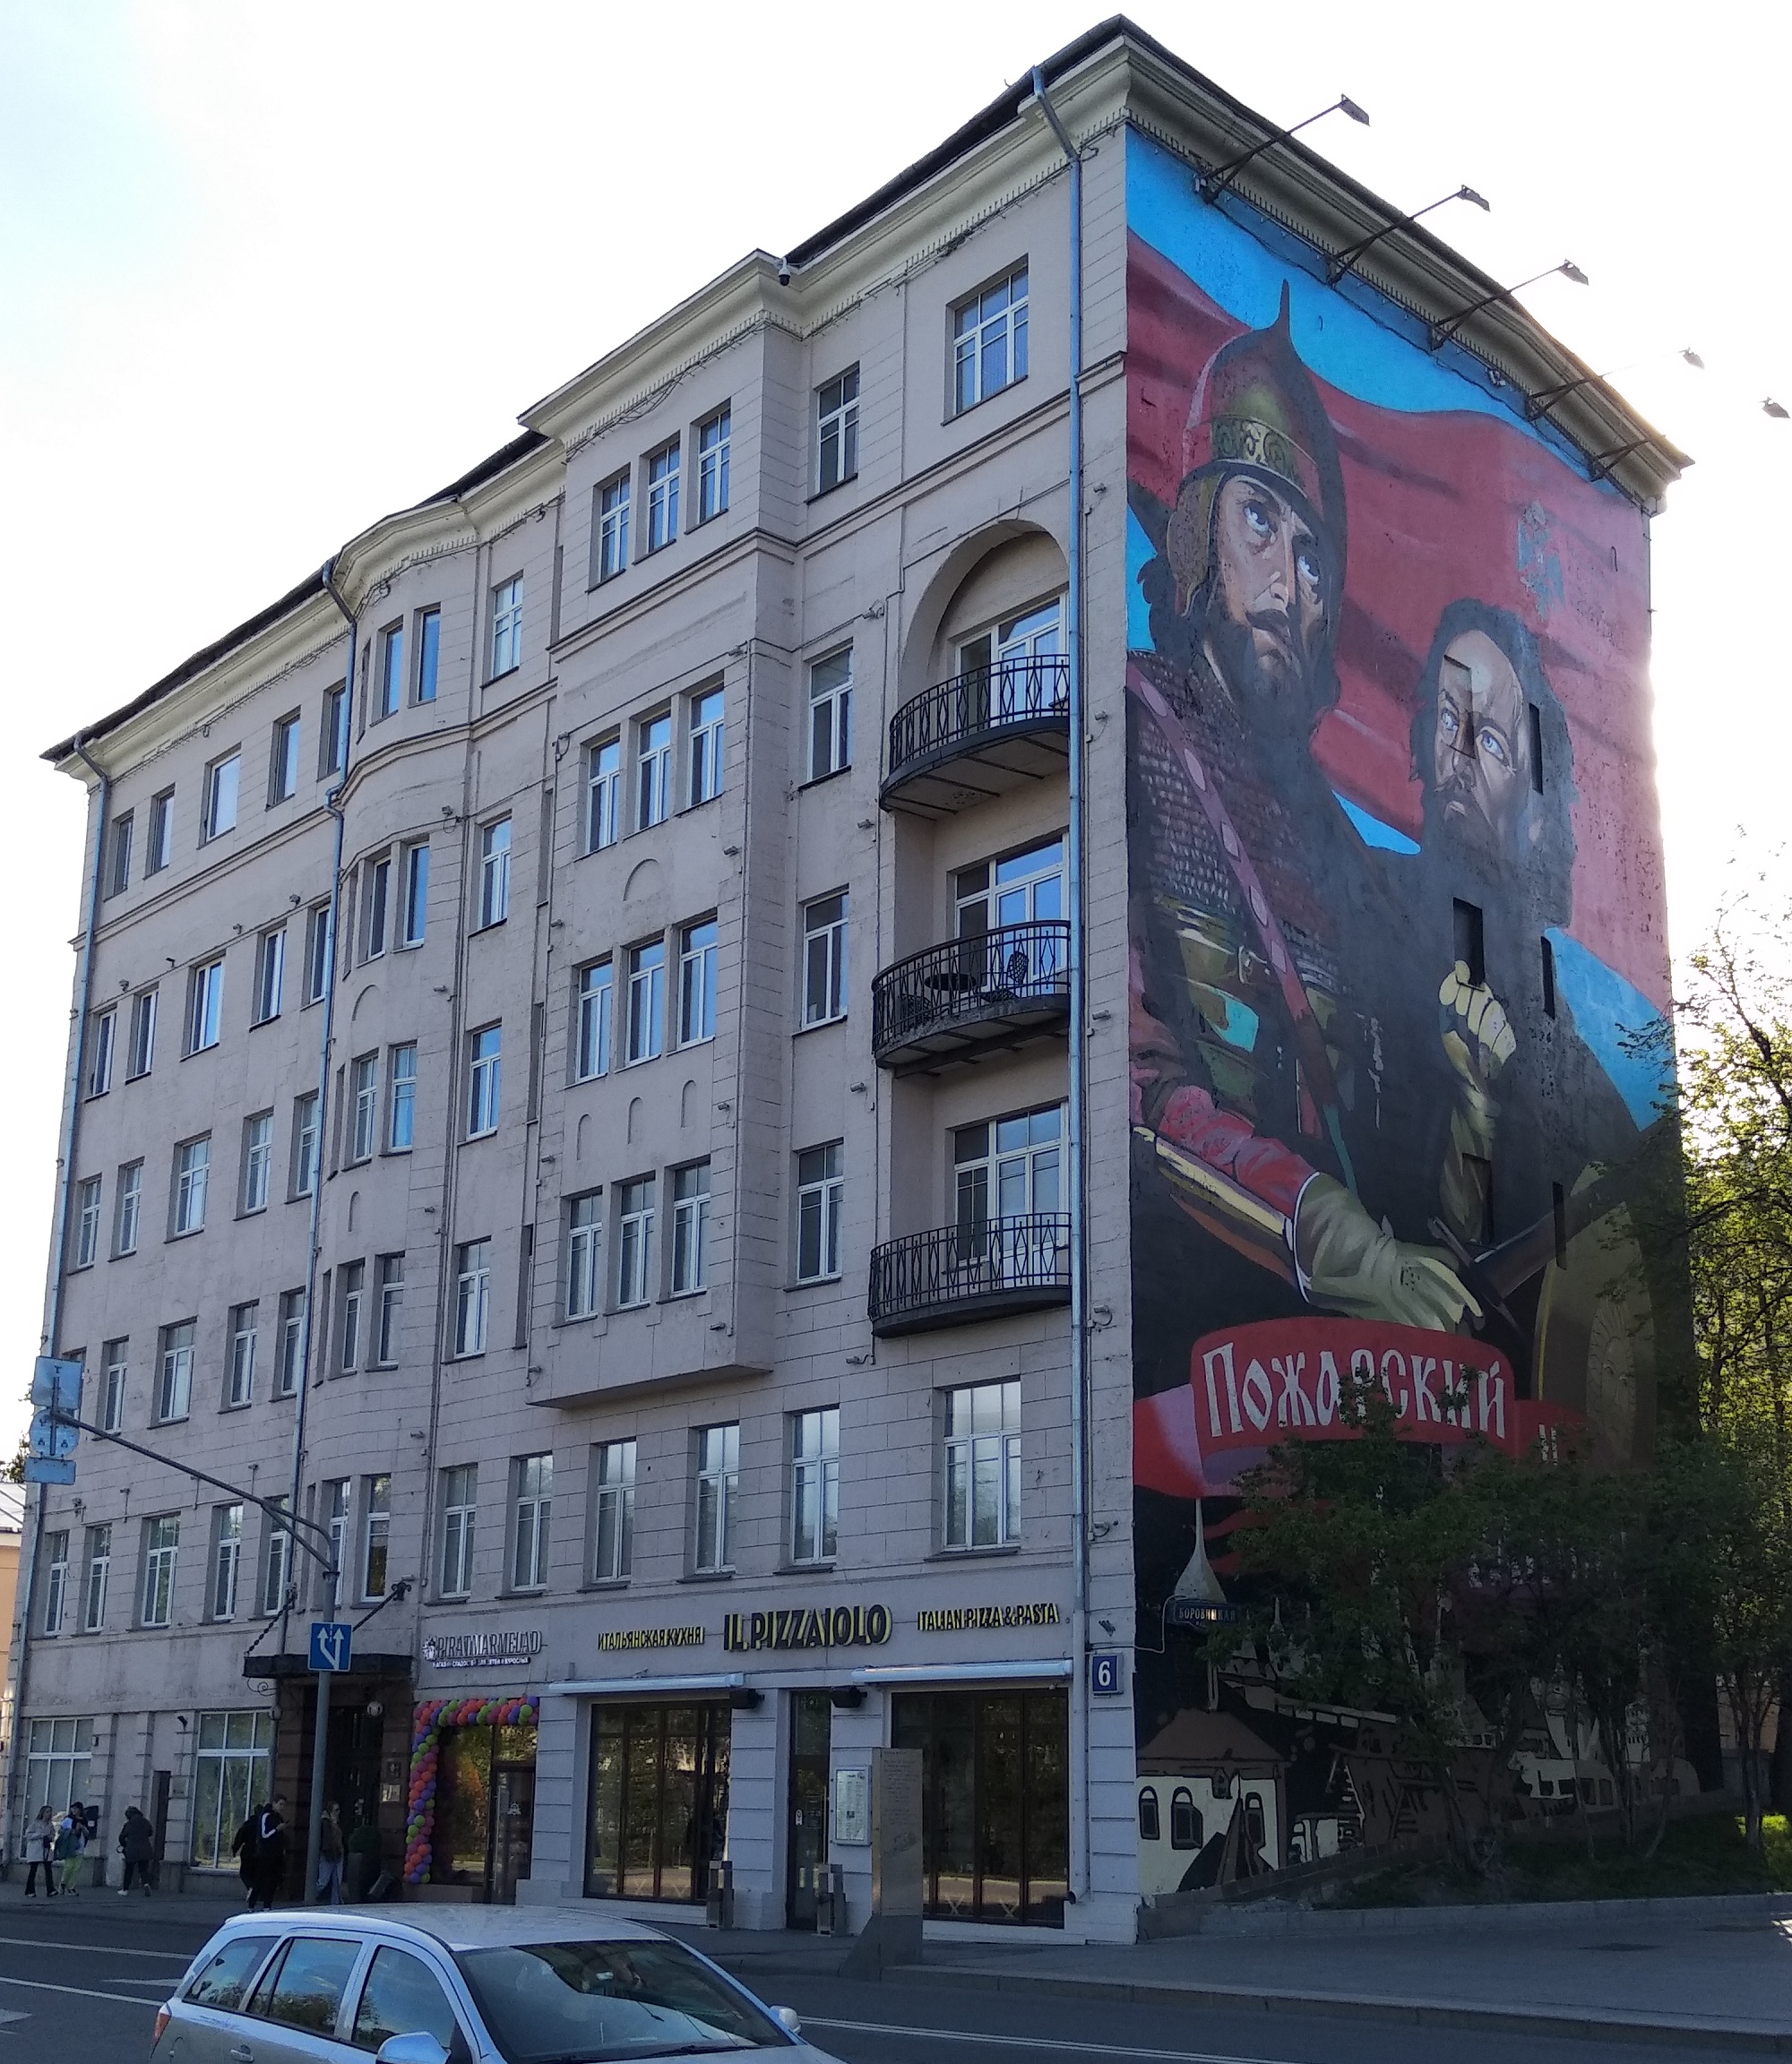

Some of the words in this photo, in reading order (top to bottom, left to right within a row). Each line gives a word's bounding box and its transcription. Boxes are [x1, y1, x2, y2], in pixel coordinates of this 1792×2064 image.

[724, 1612, 747, 1651] IL
[750, 1604, 892, 1650] PIZZAIOLO
[918, 1608, 965, 1631] ITALIAN
[966, 1606, 1004, 1628] PIZZA
[1004, 1605, 1016, 1627] &
[1017, 1603, 1060, 1625] PASTA
[598, 1629, 668, 1651] ИТАЛЬЯНСКАЯ
[668, 1626, 705, 1647] КУХНЯ
[1098, 1660, 1111, 1687] 6
